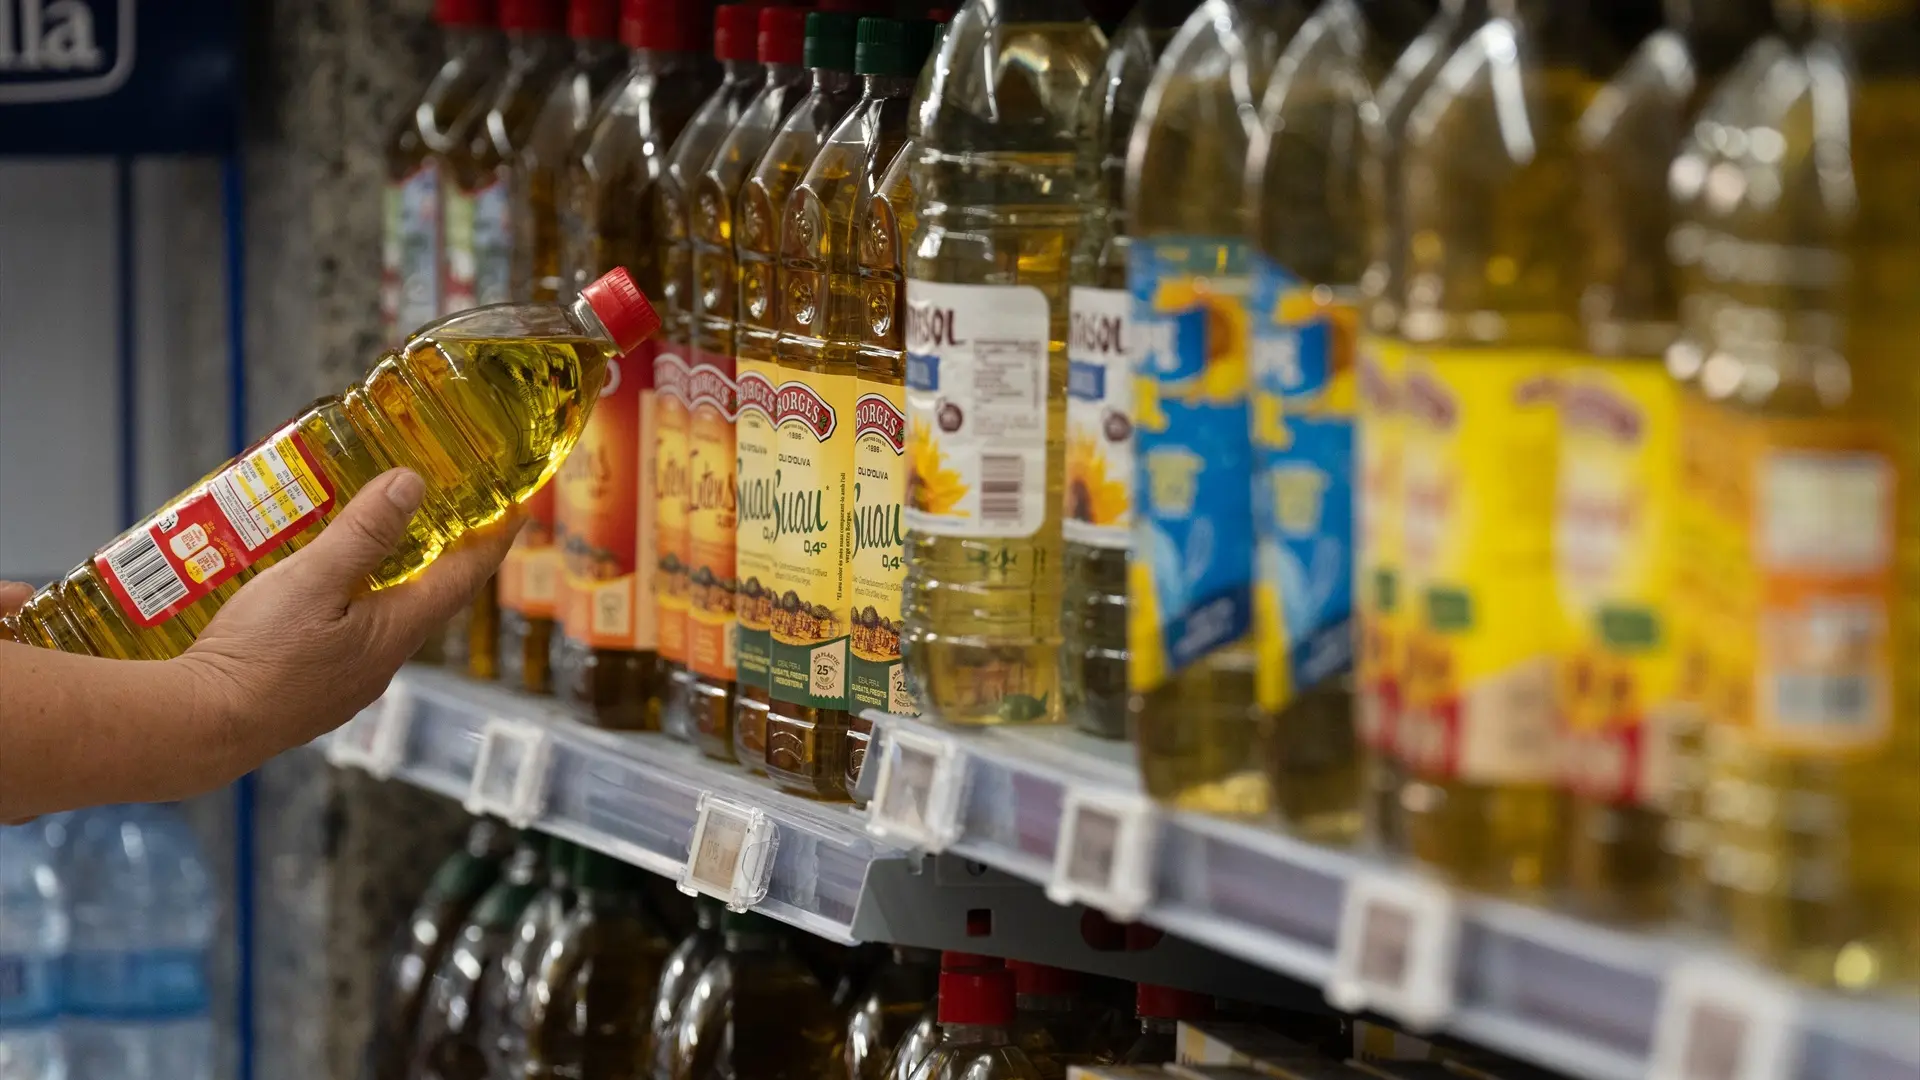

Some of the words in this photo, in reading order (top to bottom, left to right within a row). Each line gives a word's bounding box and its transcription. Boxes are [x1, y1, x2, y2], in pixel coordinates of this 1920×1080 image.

[777, 391, 820, 424] BORGES
[856, 403, 898, 437] BORGES
[778, 453, 787, 463] OLI
[858, 466, 867, 476] OLI
